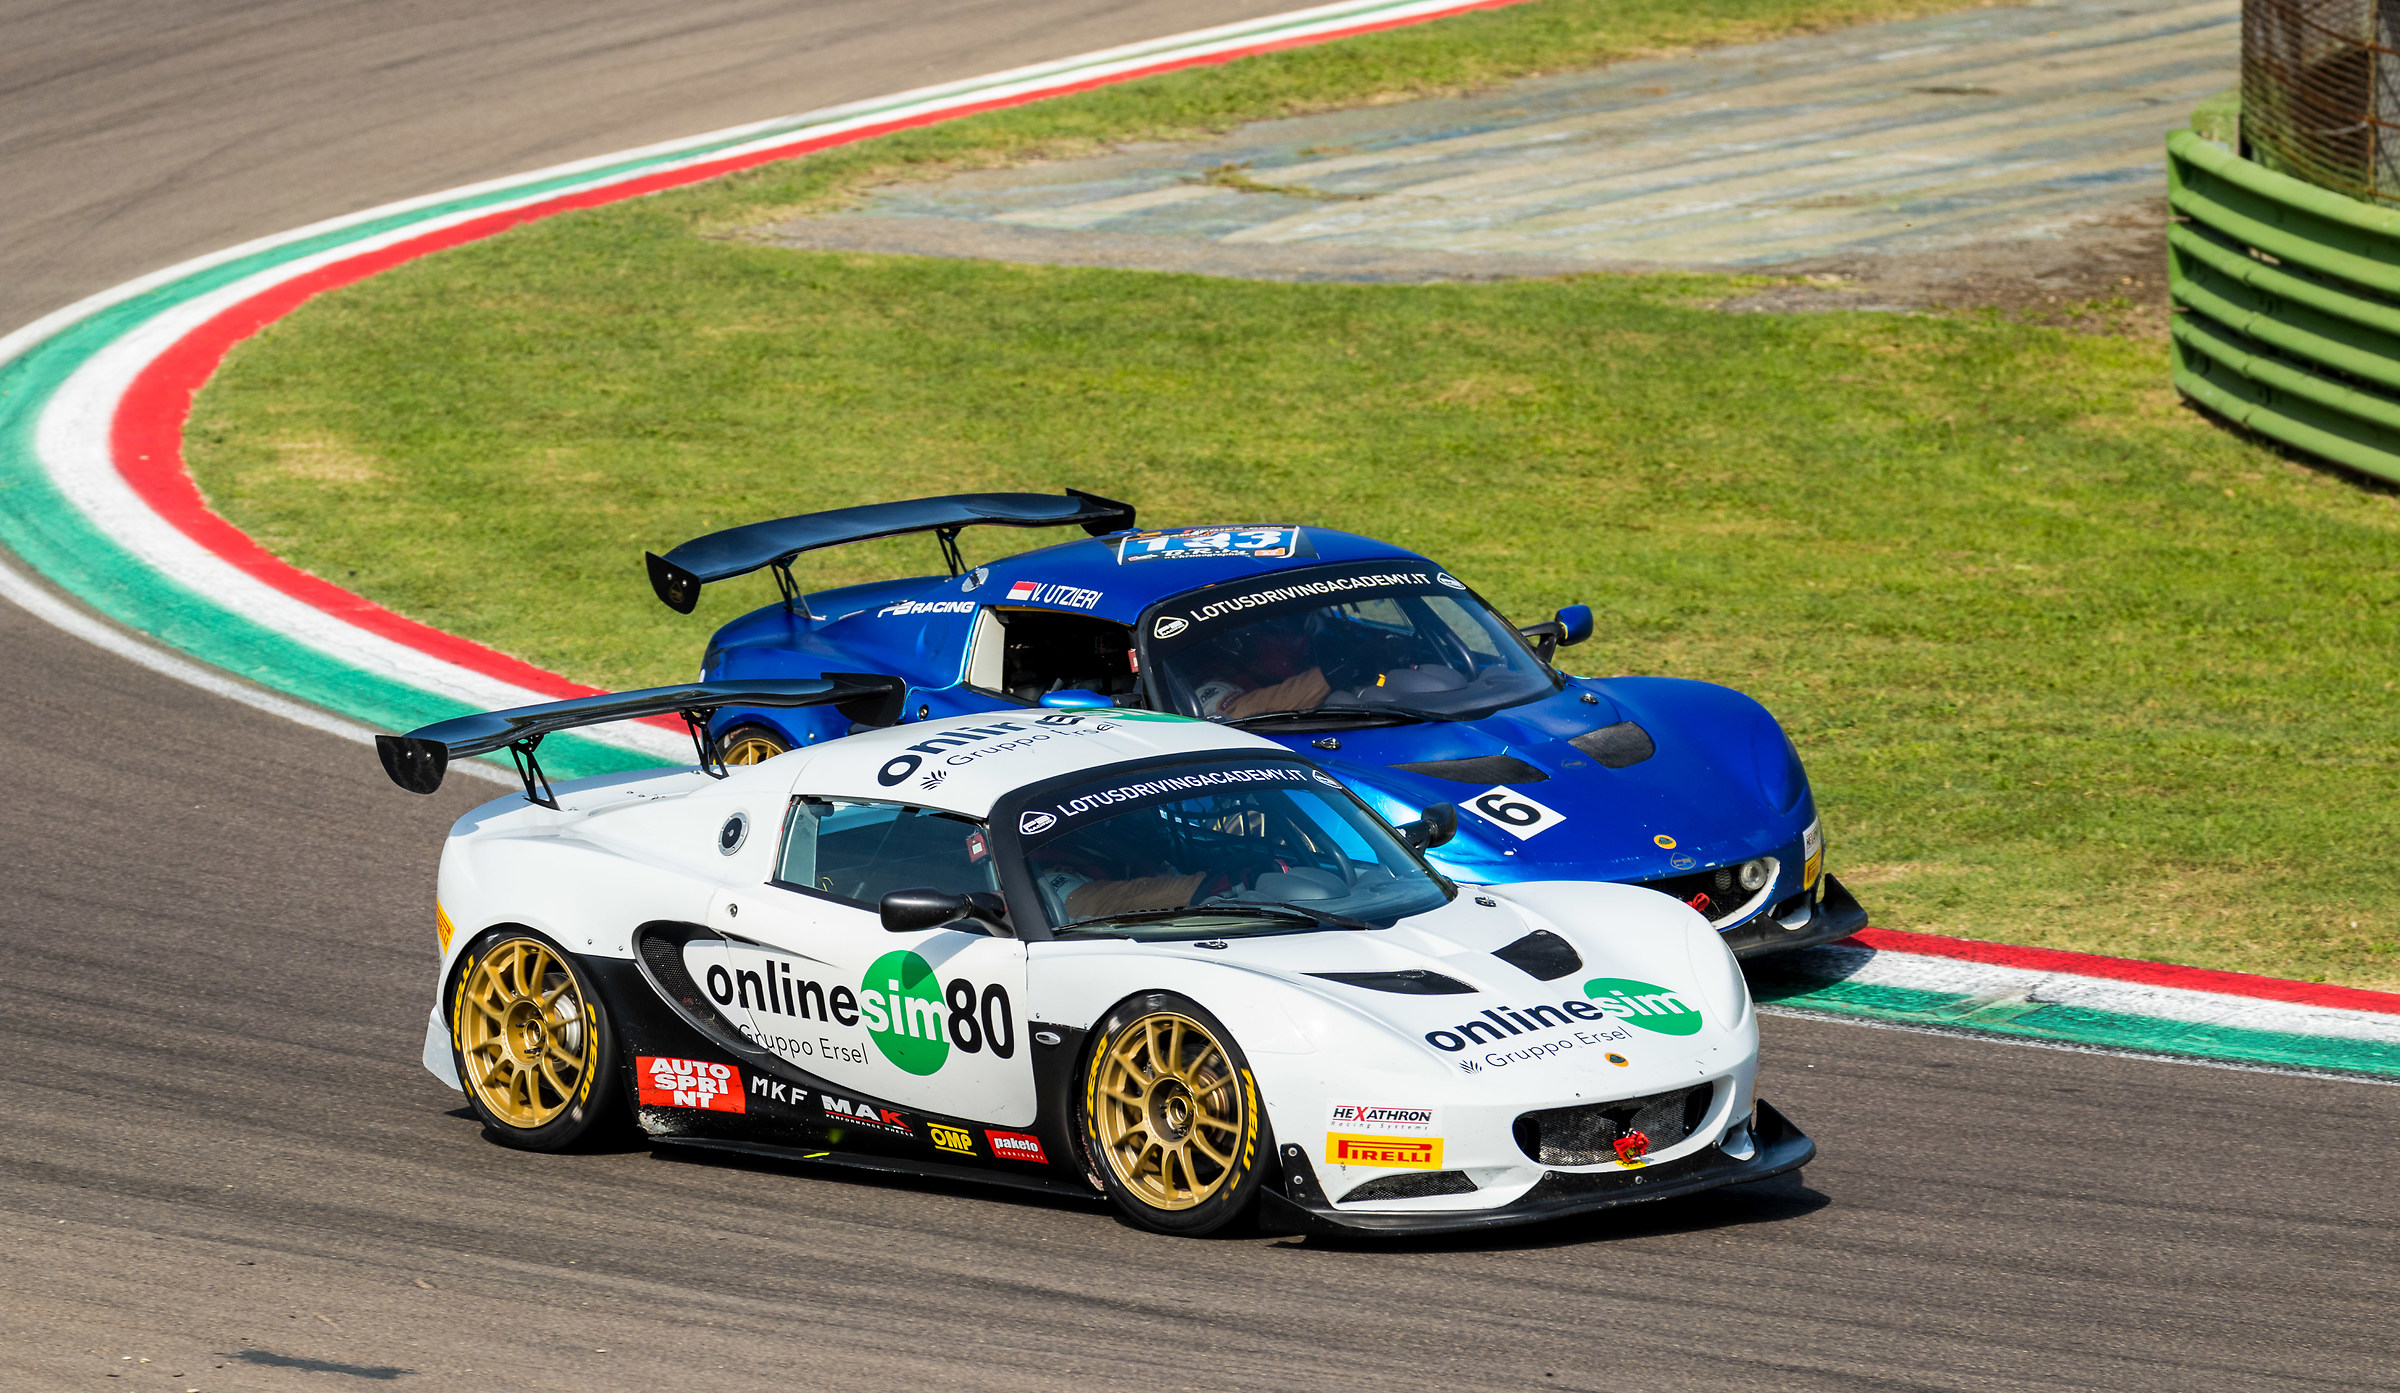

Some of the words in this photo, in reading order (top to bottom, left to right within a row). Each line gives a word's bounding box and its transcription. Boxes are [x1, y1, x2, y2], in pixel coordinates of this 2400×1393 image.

[911, 601, 976, 614] RACING
[1032, 582, 1048, 602] V.
[1044, 584, 1104, 610] UTZIERI
[1190, 573, 1432, 622] LOTUSDRIVINGACADEMY.IT
[946, 736, 1051, 766] Gruppo
[1056, 769, 1309, 818] LOTUSDRIVINGACADEMY.IT
[1475, 793, 1541, 826] 6
[819, 1037, 869, 1065] Ersel
[1485, 1037, 1574, 1068] Gruppo
[1574, 1025, 1633, 1046] Ersel
[649, 1057, 731, 1080] AUTO
[654, 1073, 729, 1095] SPRI
[751, 1075, 808, 1105] MKF
[673, 1089, 713, 1109] NT
[821, 1094, 910, 1129] MAK
[825, 1113, 881, 1130] PERFORMANCE
[884, 1127, 914, 1138] WHEELS
[1333, 1106, 1432, 1122] HEXATHRON
[930, 1128, 972, 1151] OMP
[1338, 1139, 1432, 1162] PIRELLI
